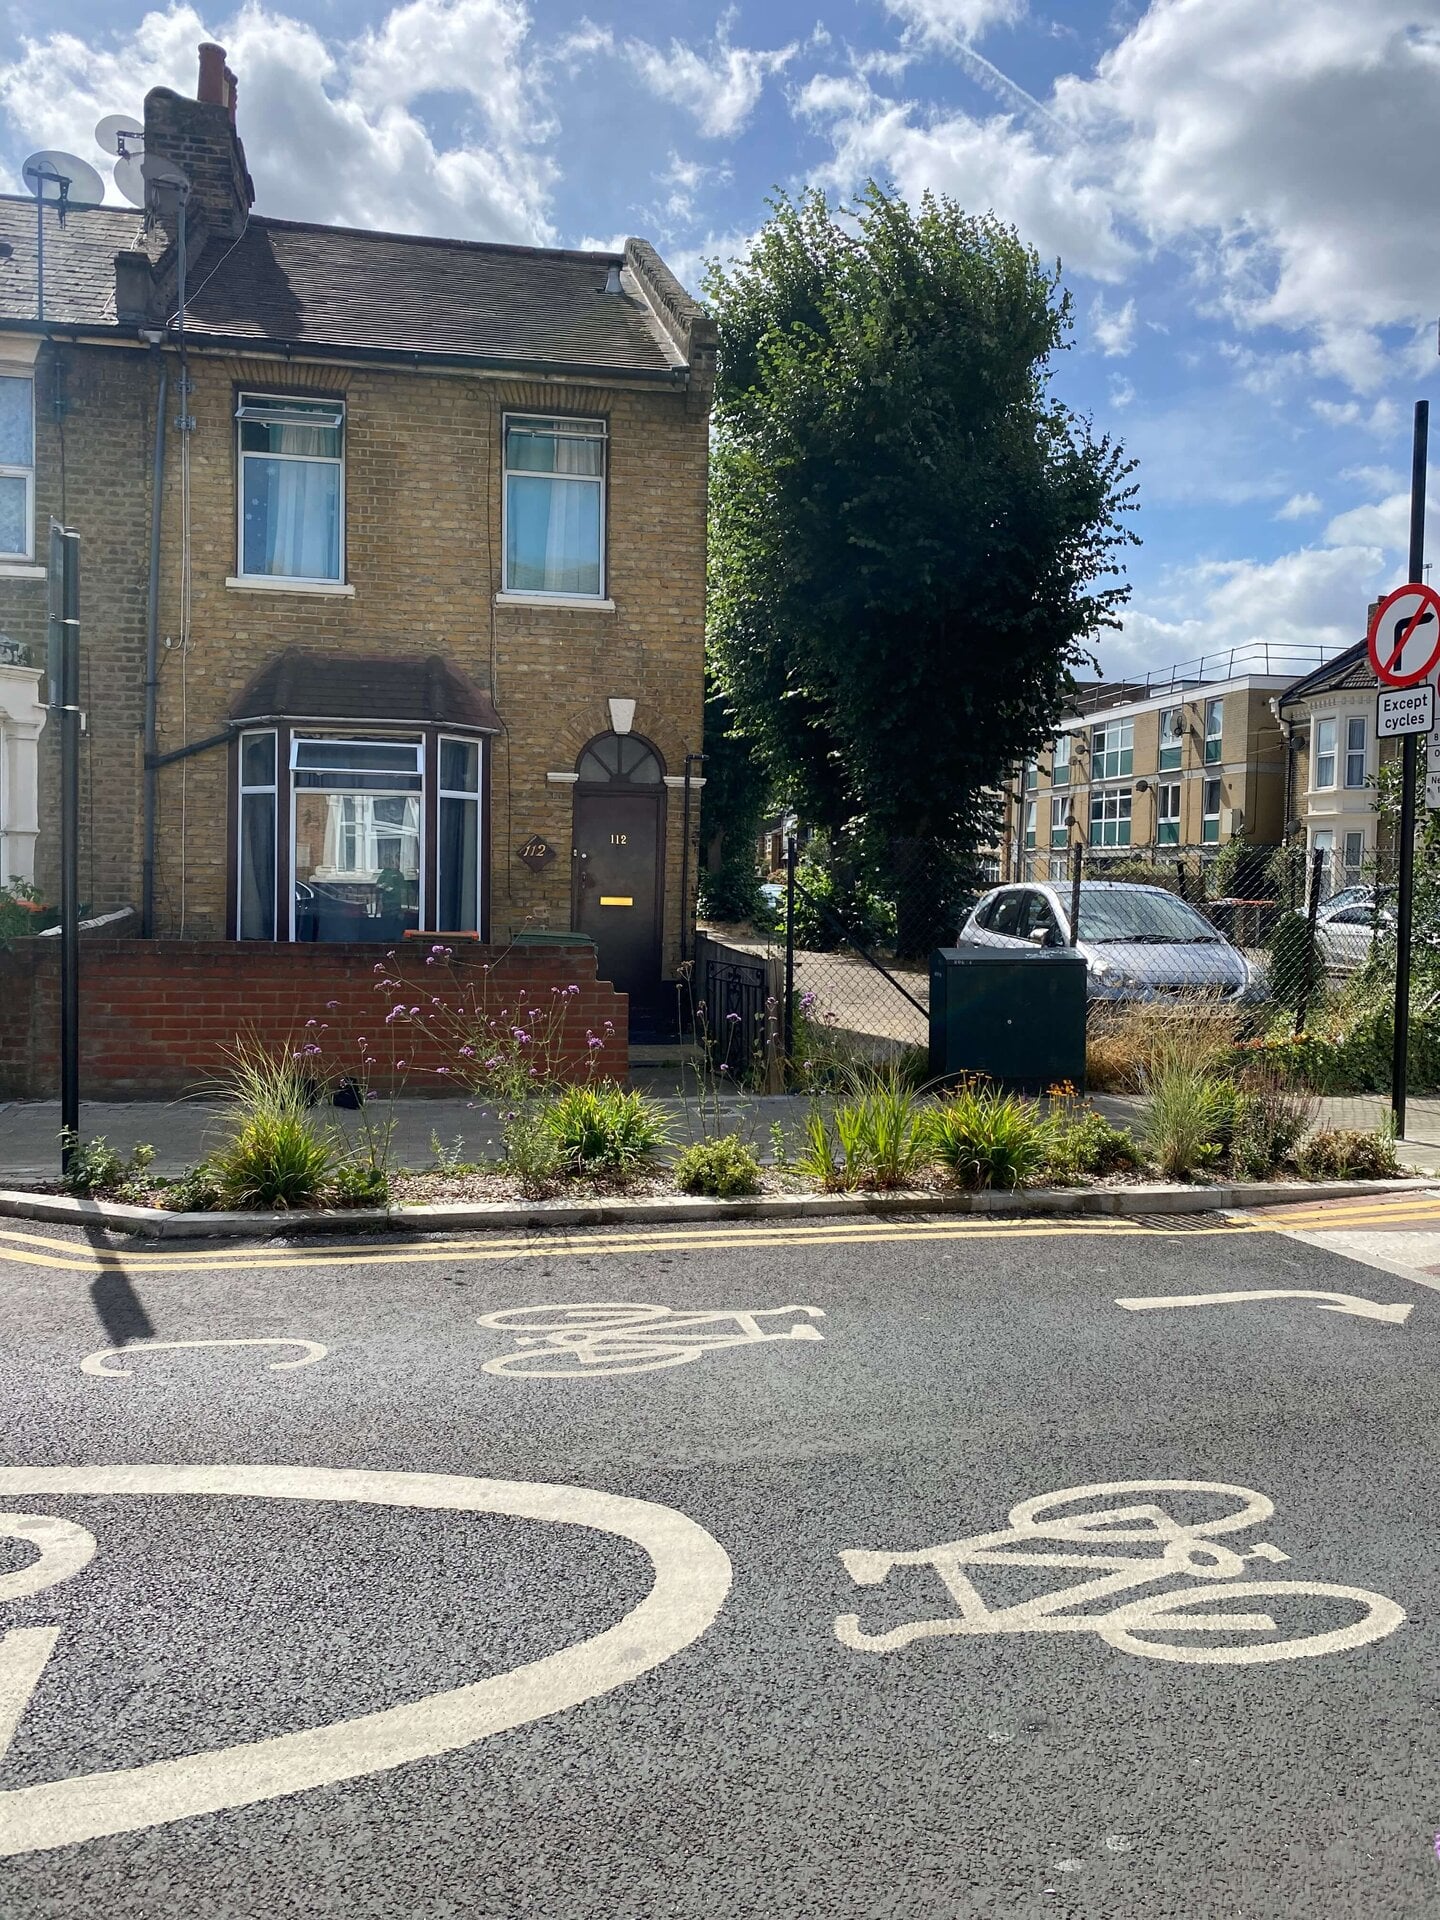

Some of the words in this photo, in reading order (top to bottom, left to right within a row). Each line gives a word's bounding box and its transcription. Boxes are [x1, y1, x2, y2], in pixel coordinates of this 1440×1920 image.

[1384, 694, 1428, 712] Except
[1385, 713, 1425, 730] cycles
[610, 834, 627, 844] 112
[523, 844, 546, 857] 112
